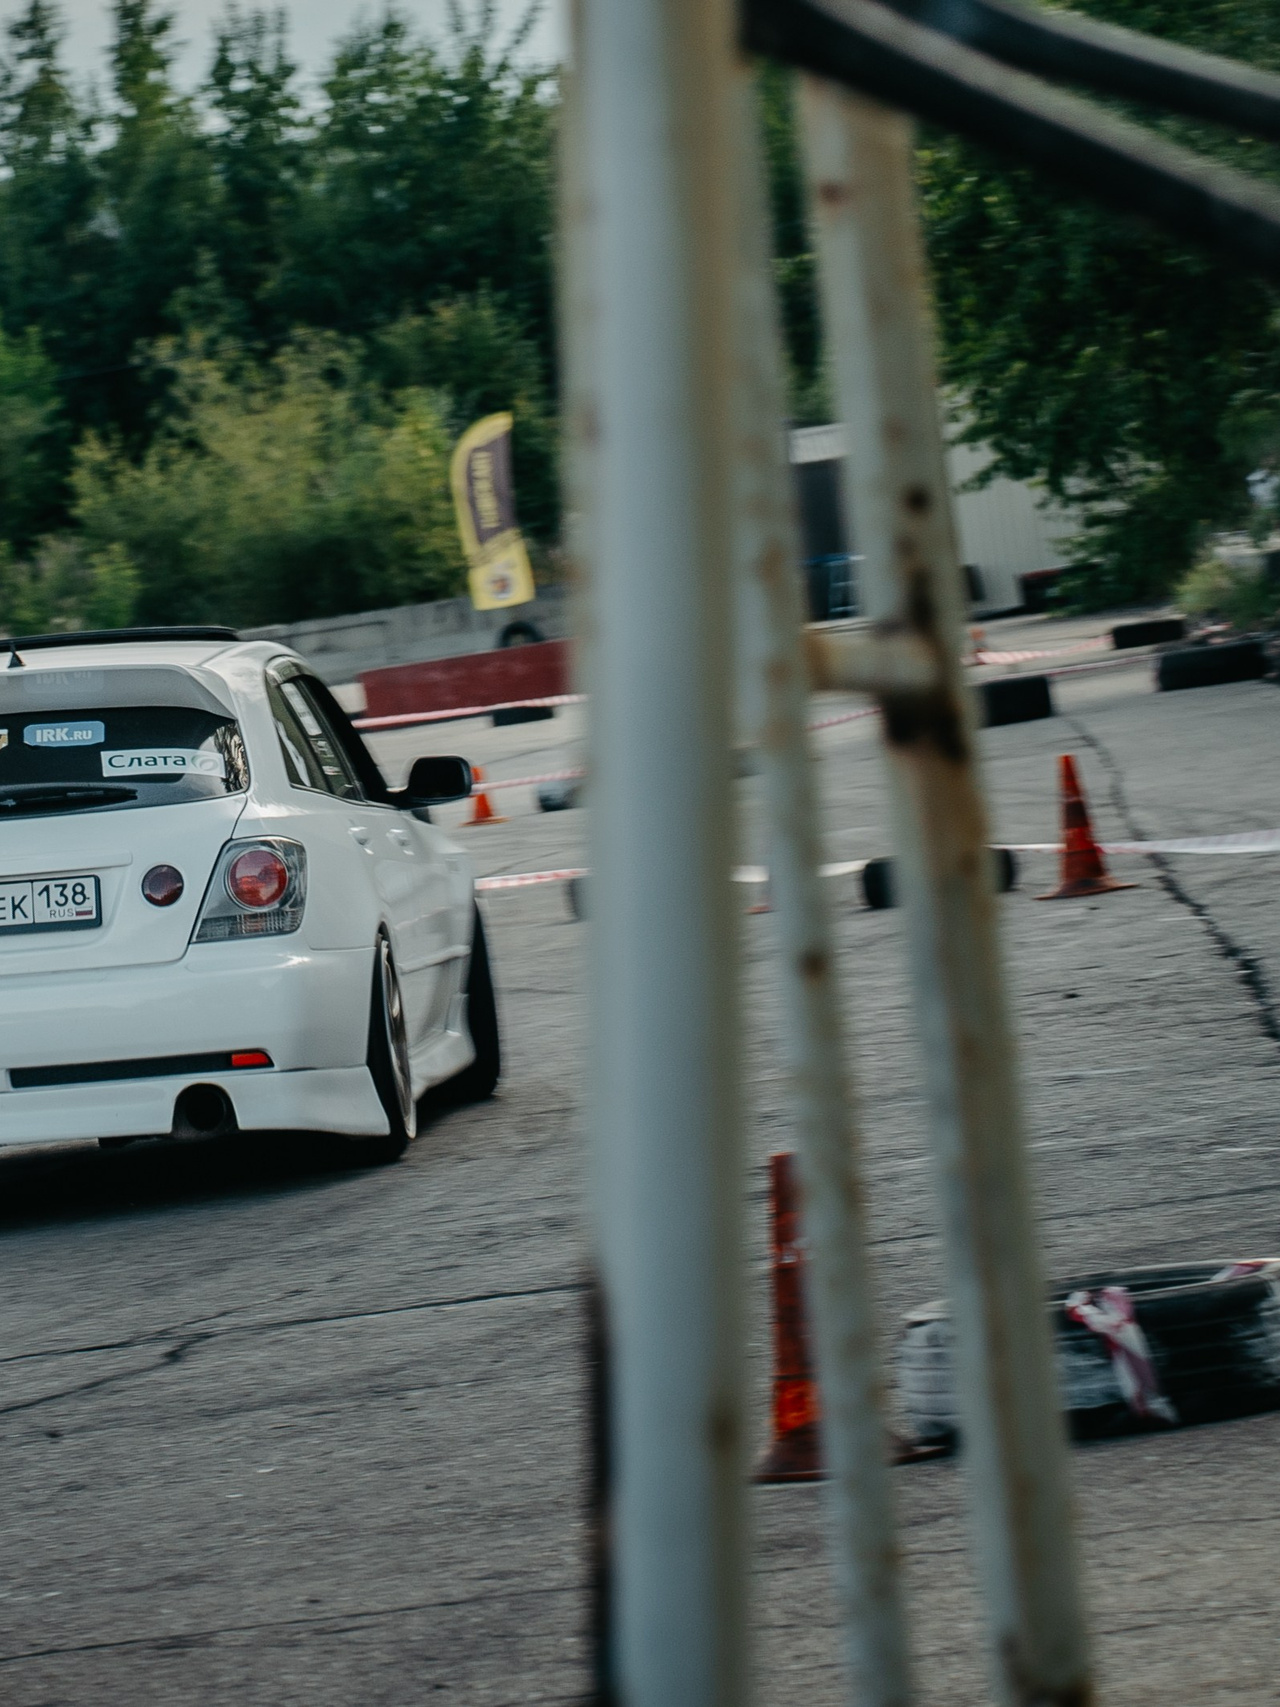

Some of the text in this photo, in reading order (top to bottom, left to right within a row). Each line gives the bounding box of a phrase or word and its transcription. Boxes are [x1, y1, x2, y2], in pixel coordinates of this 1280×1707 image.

[35, 727, 92, 743] IRK.RU
[108, 754, 187, 769] Слата
[37, 882, 87, 909] 138
[49, 907, 74, 919] RUS
